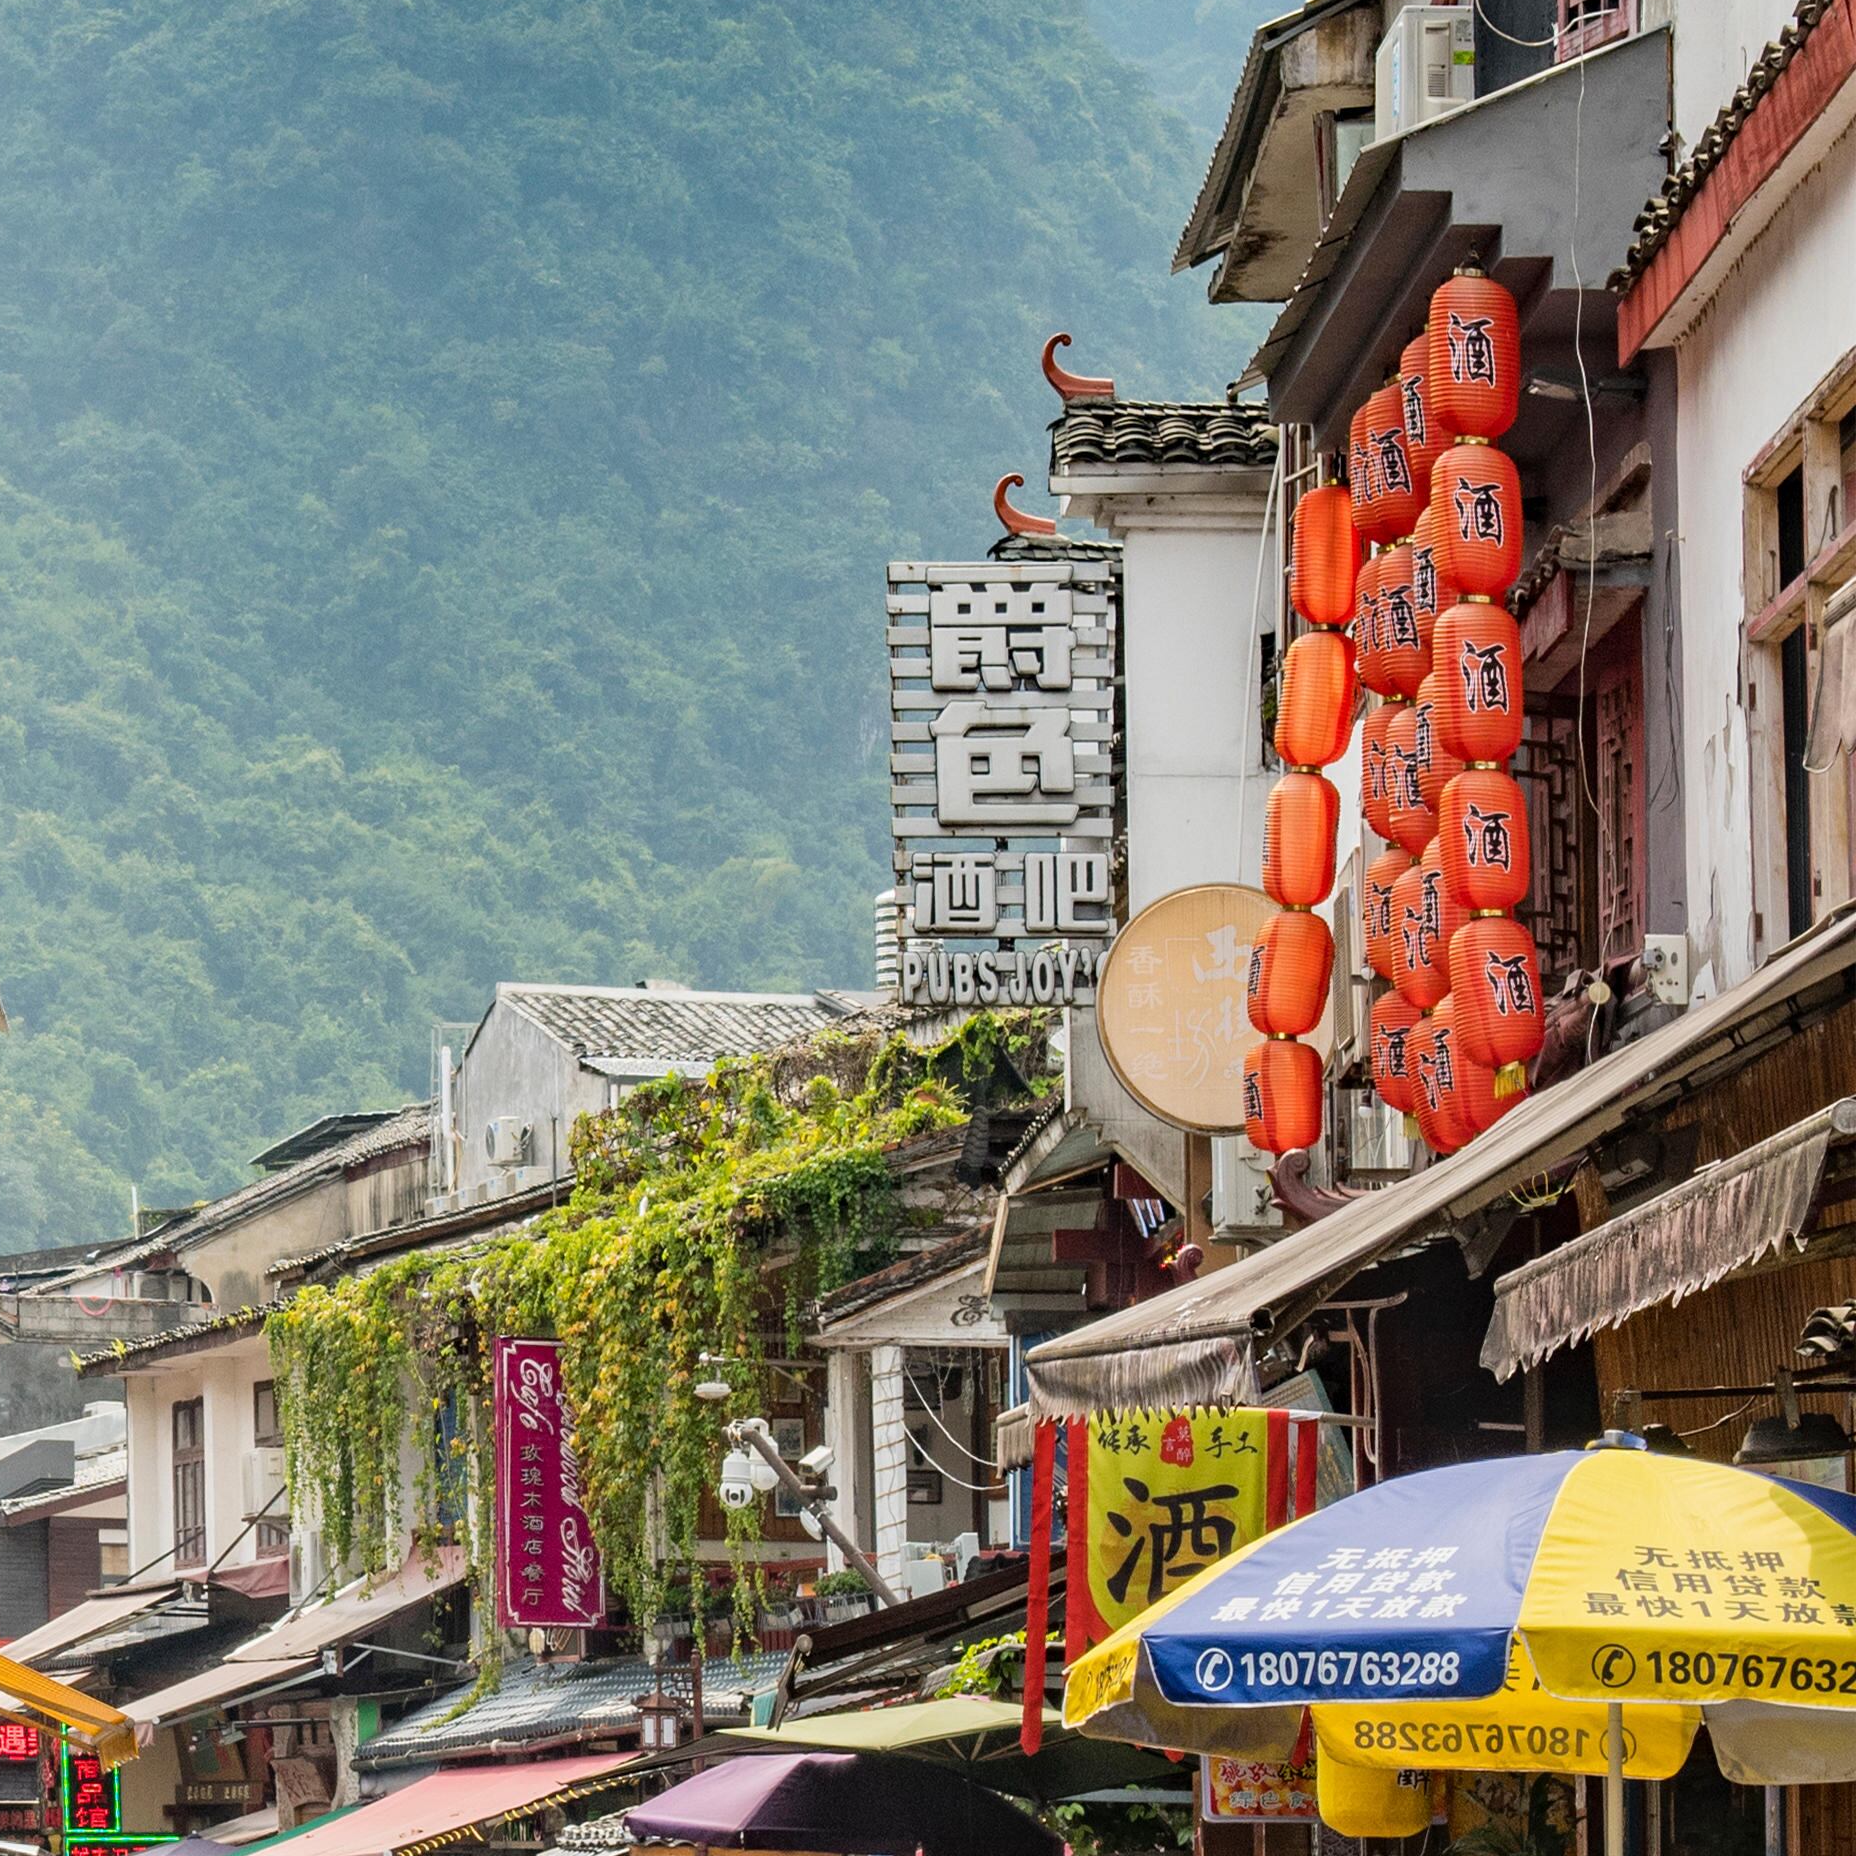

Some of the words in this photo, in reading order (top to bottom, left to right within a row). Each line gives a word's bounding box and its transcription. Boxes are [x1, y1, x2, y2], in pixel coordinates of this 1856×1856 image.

[1447, 311, 1496, 389] 酒
[1368, 427, 1413, 495] 酒
[1453, 476, 1504, 549] 酒
[1379, 584, 1421, 653] 酒
[926, 564, 1081, 827] 爵色
[1459, 639, 1510, 716] 酒
[1462, 802, 1512, 874] 酒
[910, 850, 1112, 934] 酒吧
[901, 949, 1001, 1008] PUBS
[1008, 946, 1106, 1007] JOY'
[1484, 949, 1537, 1017] 酒
[1125, 945, 1171, 1083] 香酥一绝
[1097, 1424, 1152, 1455] 传承
[520, 1445, 545, 1607] 玫瑰木酒店餐厅
[1106, 1476, 1240, 1606] 酒
[1317, 1545, 1460, 1571] 无抵押
[1633, 1545, 1786, 1574] 无抵押
[1210, 1592, 1469, 1623] 最快1天放款
[1272, 1569, 1458, 1597] 信用贷款
[1614, 1567, 1828, 1601] 信用贷款
[1239, 1650, 1461, 1687] 18076763288
[1645, 1650, 1856, 1695] 180767632
[1228, 1790, 1320, 1810] 绿色食
